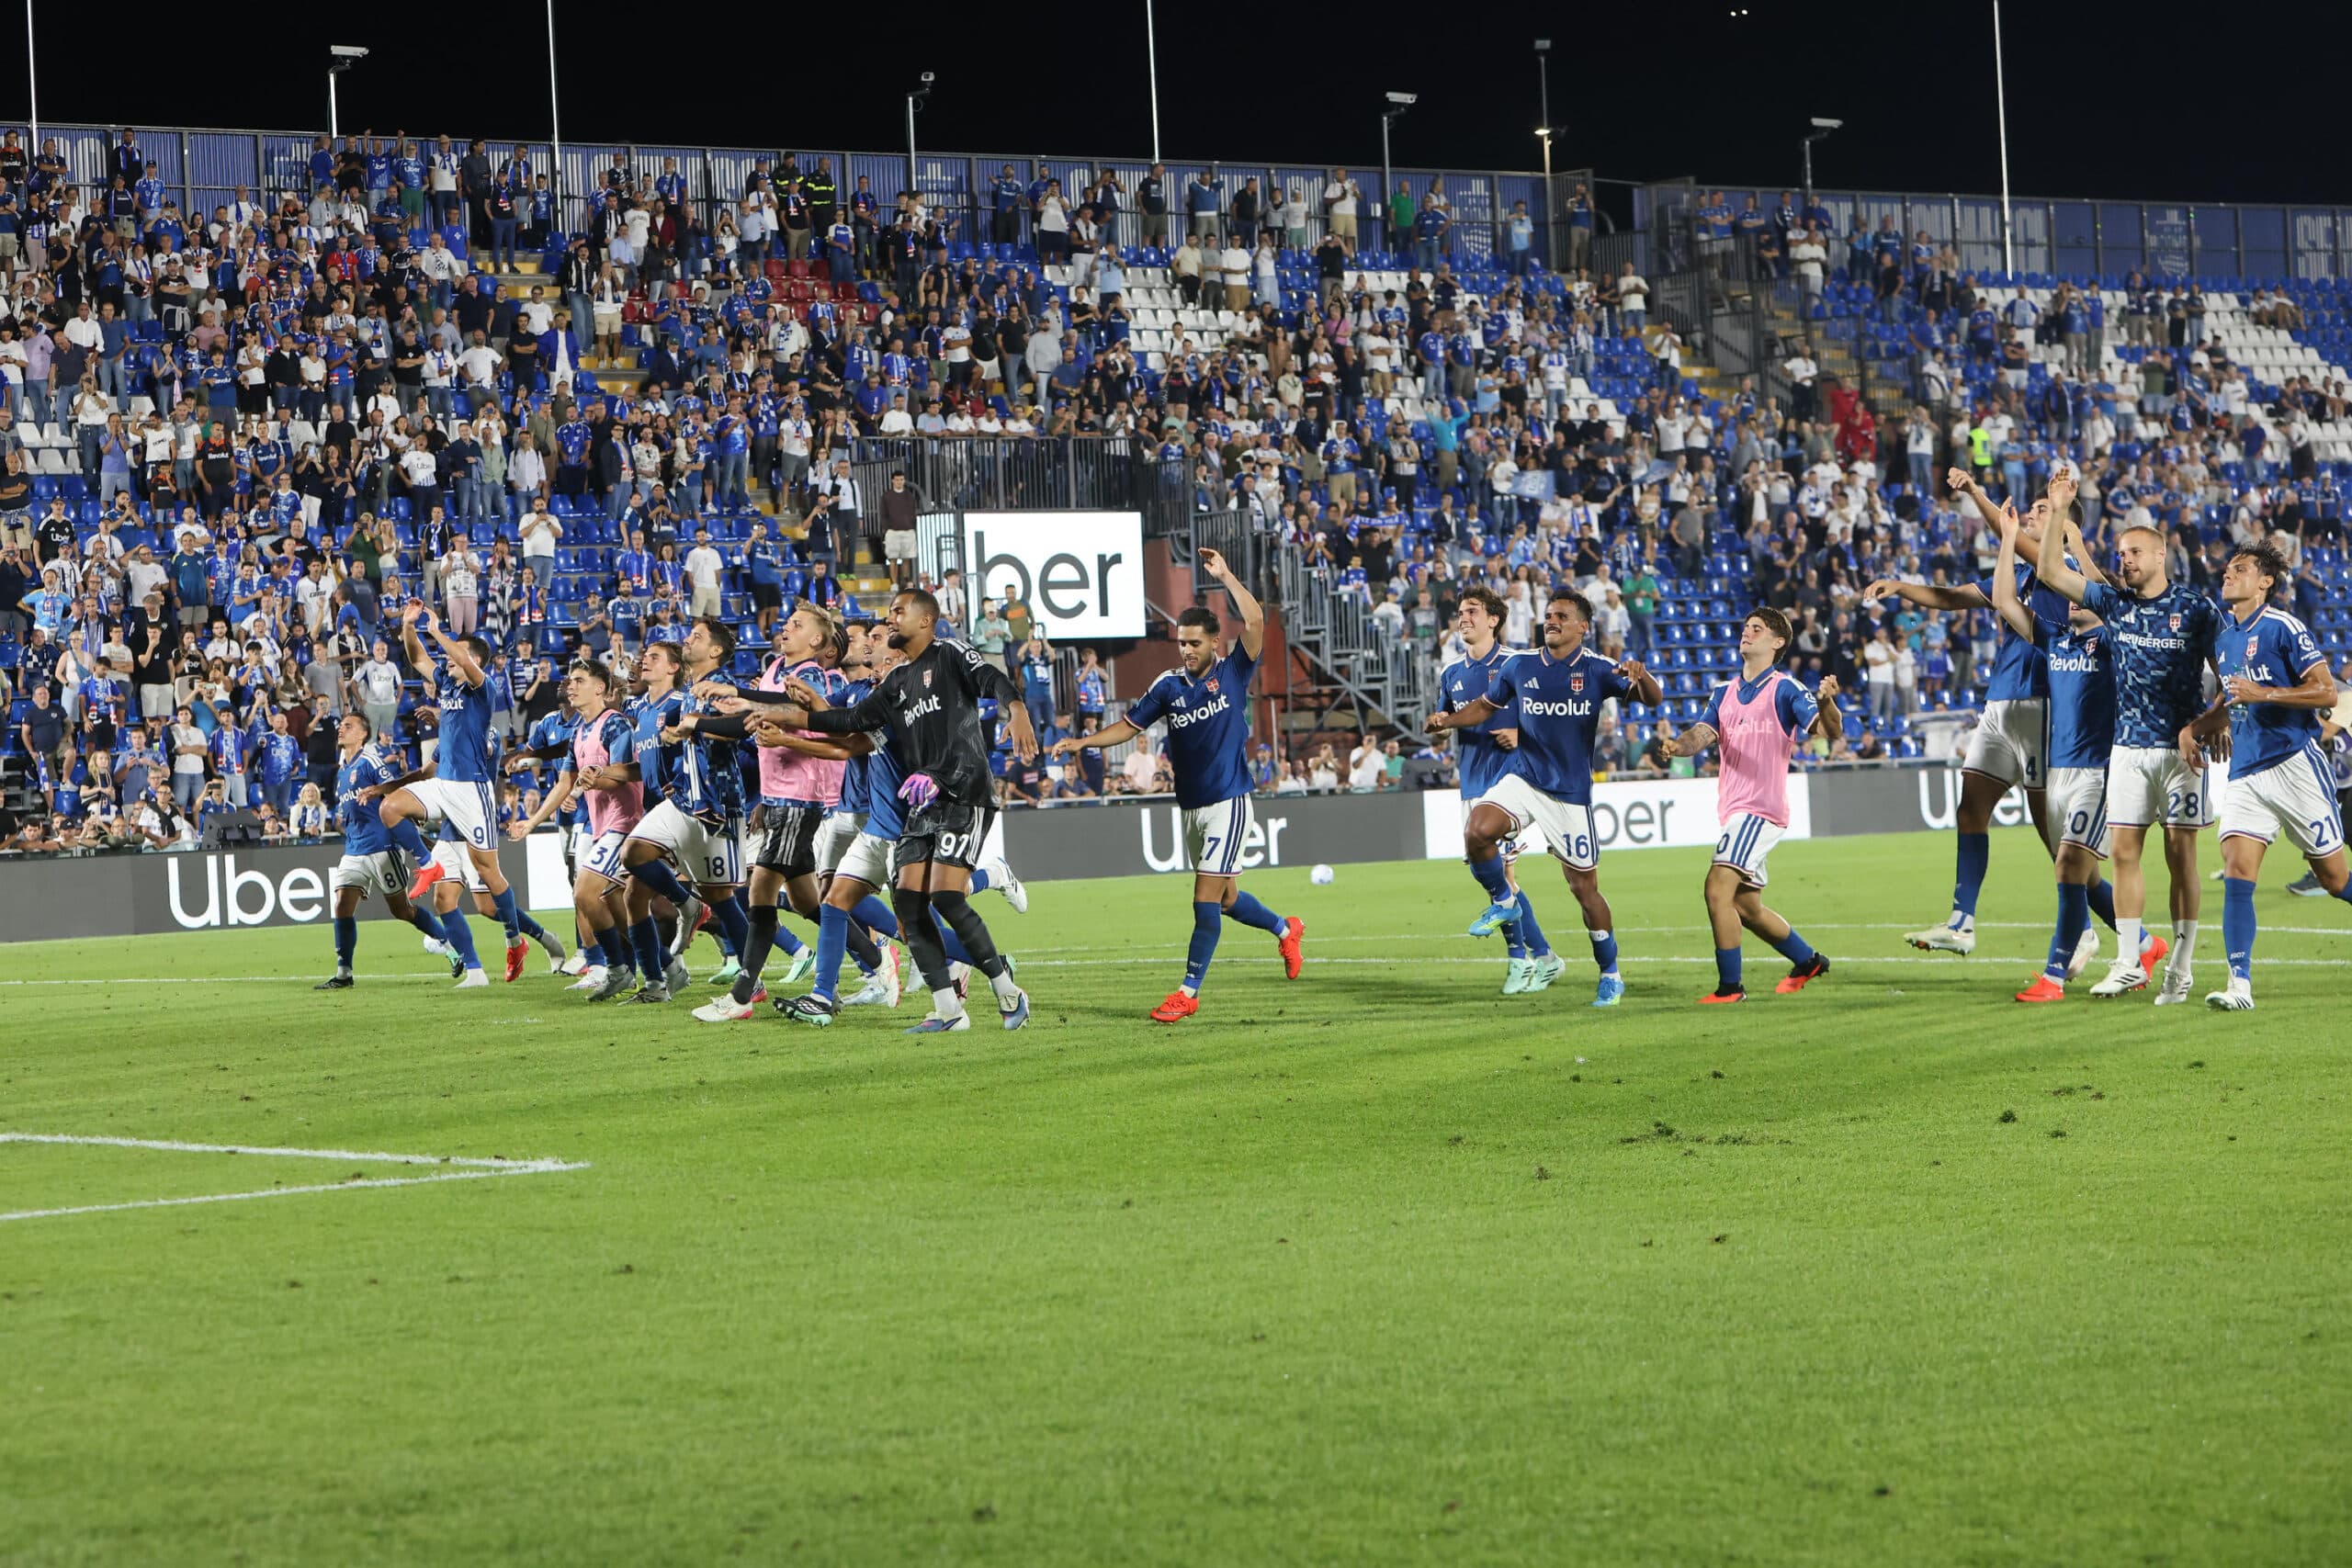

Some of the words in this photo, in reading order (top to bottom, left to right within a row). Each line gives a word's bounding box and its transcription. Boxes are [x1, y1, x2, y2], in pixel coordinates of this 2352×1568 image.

[51, 533, 71, 542] Uber
[2119, 631, 2186, 649] NEUBERGER
[2049, 653, 2099, 673] Revolut
[903, 694, 942, 728] Revolut
[1168, 694, 1230, 730] Revolut
[1522, 697, 1591, 716] Revolut
[2025, 756, 2037, 781] 4
[2167, 792, 2199, 818] 28
[2067, 810, 2089, 835] 0
[2309, 815, 2338, 848] 21
[473, 827, 484, 844] 9
[939, 832, 970, 859] 91
[1141, 807, 1288, 873] Uer
[1563, 833, 1589, 860] 16
[591, 846, 609, 865] 3
[704, 856, 725, 878] 18
[384, 873, 397, 888] 8
